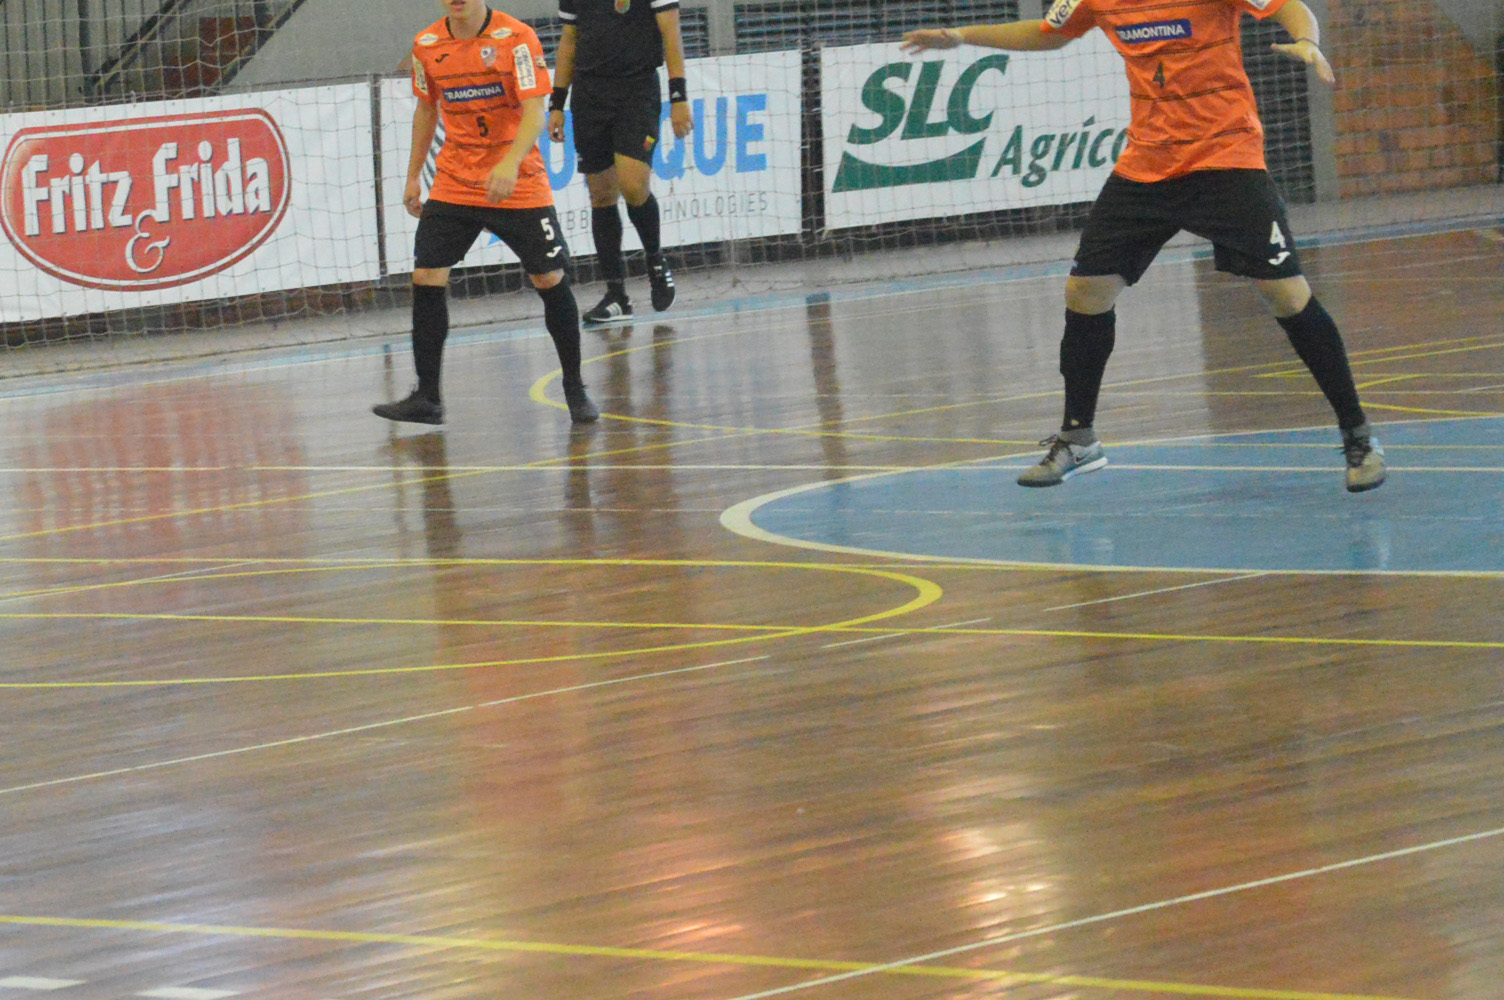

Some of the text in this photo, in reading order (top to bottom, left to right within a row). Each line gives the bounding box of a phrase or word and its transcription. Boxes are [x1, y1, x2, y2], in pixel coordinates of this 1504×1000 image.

[1116, 24, 1186, 41] RAMONTINA
[1152, 61, 1166, 89] 4
[847, 54, 1010, 145] SLC
[476, 115, 489, 138] 5
[21, 137, 272, 238] Fritz Frida
[124, 208, 171, 275] &
[540, 217, 554, 241] 5
[1269, 220, 1286, 249] 4
